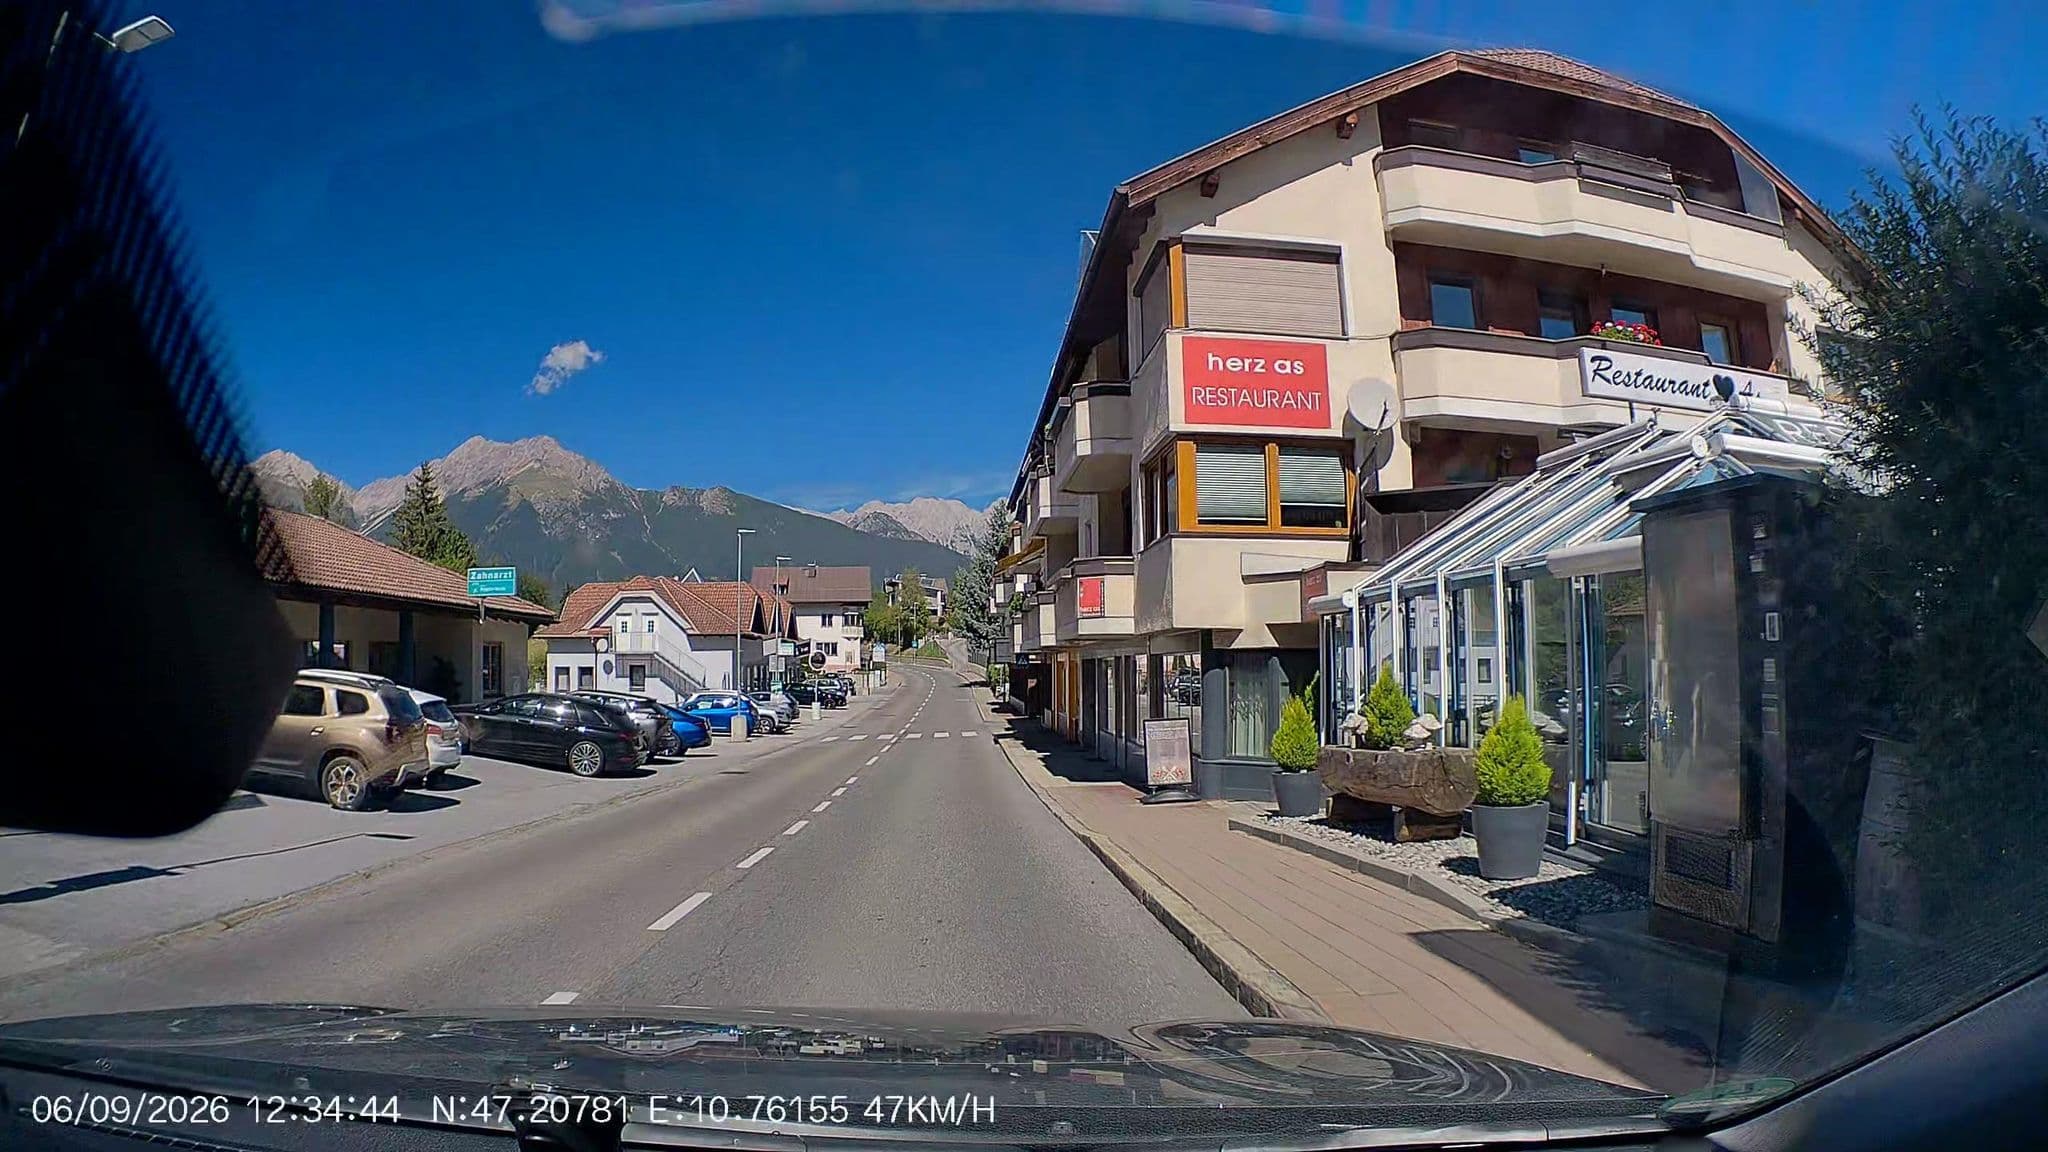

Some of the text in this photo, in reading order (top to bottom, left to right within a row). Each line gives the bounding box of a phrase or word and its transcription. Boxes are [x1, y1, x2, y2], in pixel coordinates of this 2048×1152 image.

[1207, 353, 1305, 375] herz as
[1590, 355, 1711, 398] Restaurant
[1191, 386, 1322, 411] RESTAURANT
[470, 571, 512, 580] Zahnarzt
